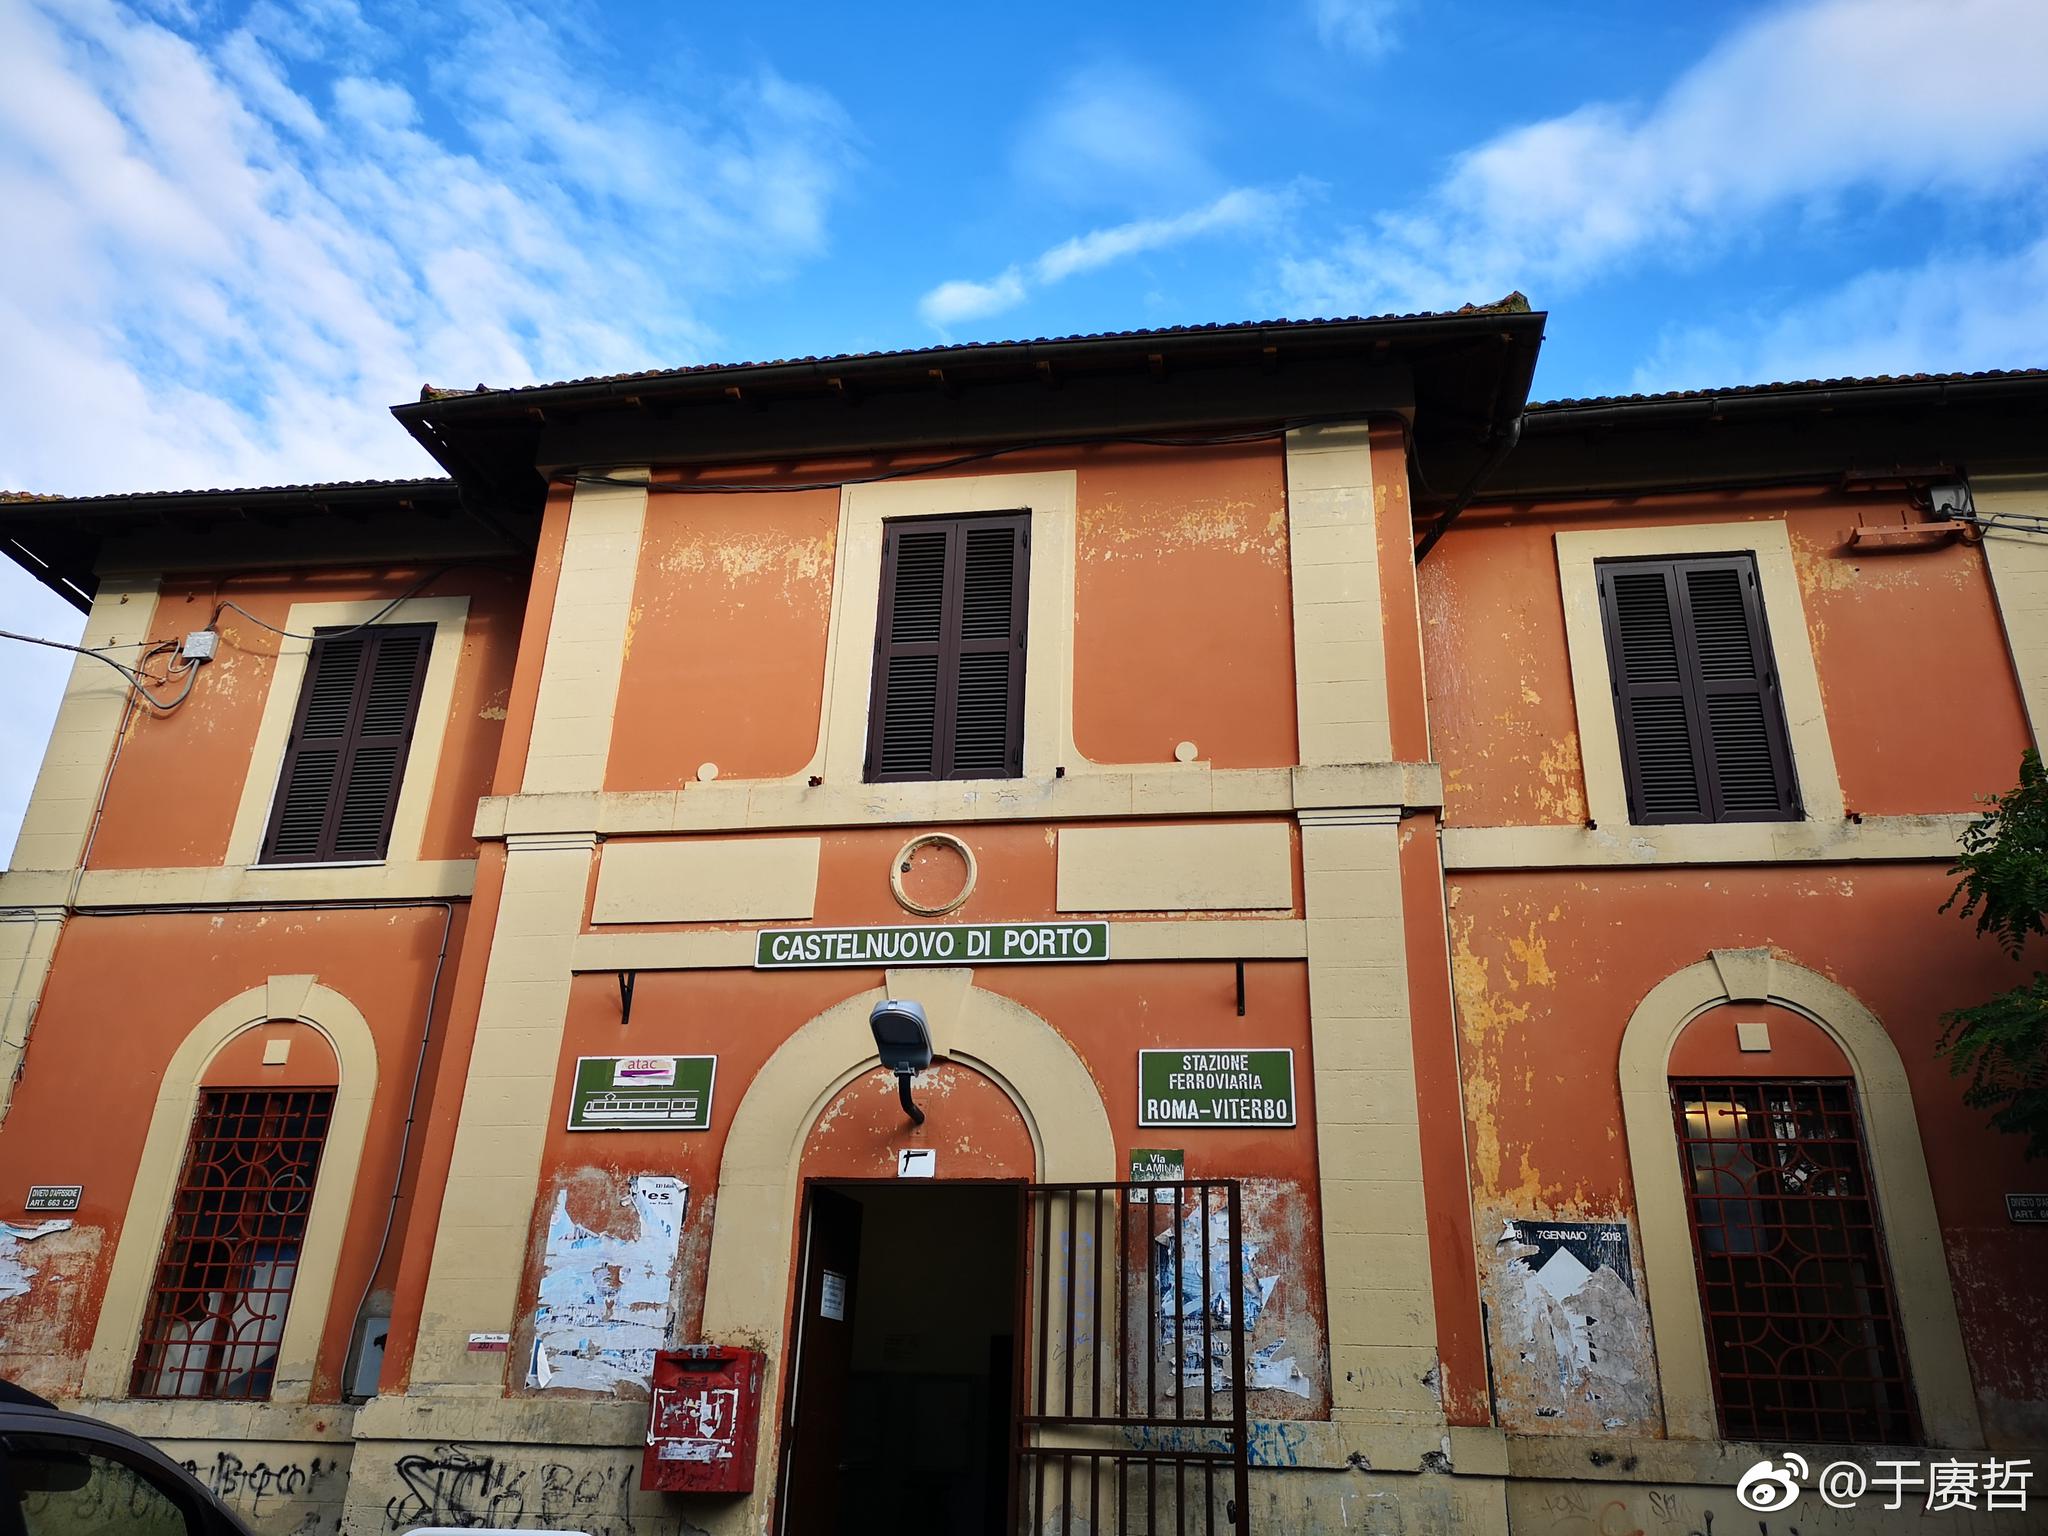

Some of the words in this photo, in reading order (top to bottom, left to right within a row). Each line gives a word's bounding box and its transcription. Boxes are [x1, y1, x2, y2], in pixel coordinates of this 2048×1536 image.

[772, 931, 953, 961] CASTELNUOVO
[967, 930, 991, 957] DI
[1003, 928, 1093, 956] PORTO
[627, 1059, 658, 1070] atac
[1183, 1054, 1249, 1071] STAZIONE
[1169, 1073, 1263, 1090] FERROVIARIA
[1150, 1154, 1166, 1164] Via
[29, 1199, 45, 1207] ART.
[47, 1199, 60, 1207] 663
[1600, 1231, 1622, 1242] 2018
